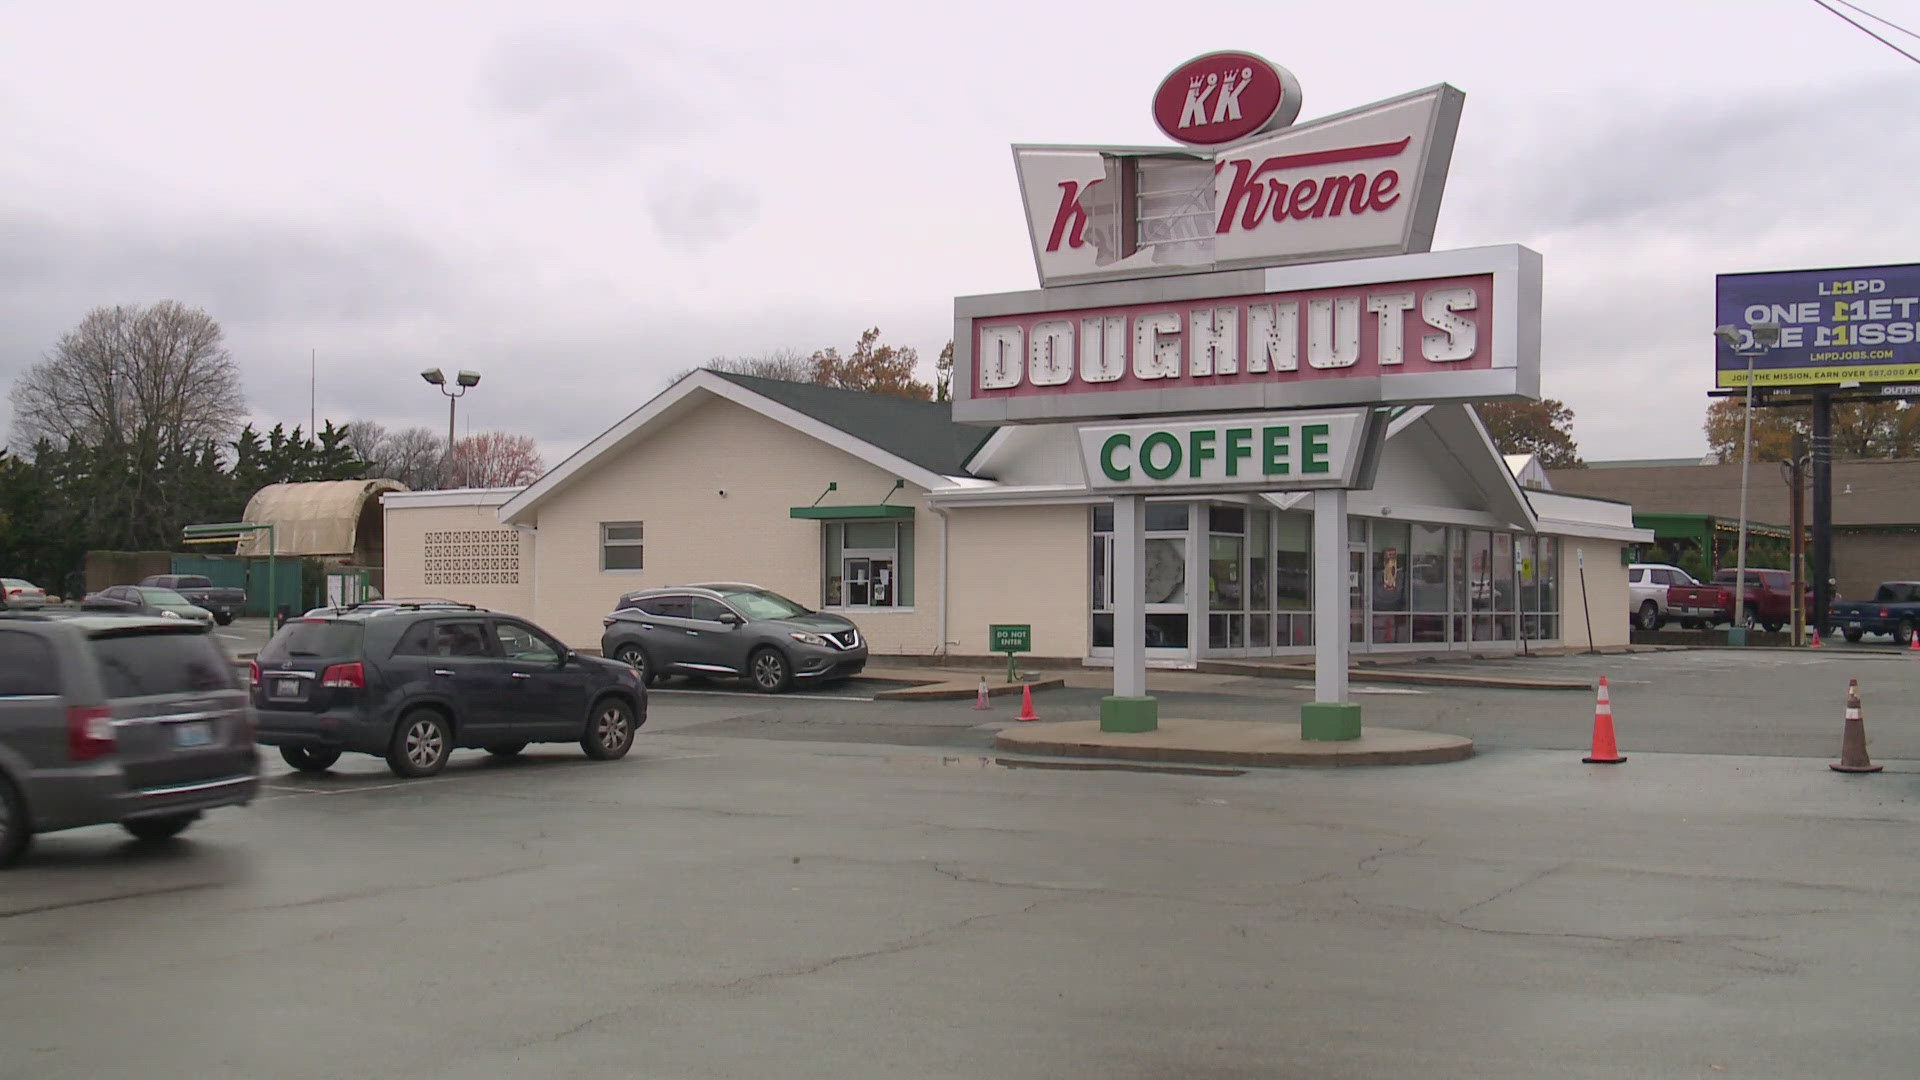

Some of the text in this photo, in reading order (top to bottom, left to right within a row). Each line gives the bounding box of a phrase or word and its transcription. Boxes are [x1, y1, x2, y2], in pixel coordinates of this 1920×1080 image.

[1215, 136, 1411, 236] Kreme
[1744, 297, 1920, 325] ONE MET
[979, 287, 1478, 390] DOUGHNUTS
[1810, 350, 1894, 362] LMPDJOBS.COM
[1754, 373, 1771, 381] THE
[1773, 372, 1812, 380] MISSION,
[1814, 371, 1839, 379] EARN
[1841, 370, 1866, 378] OVER
[1100, 424, 1330, 481] COFFEE
